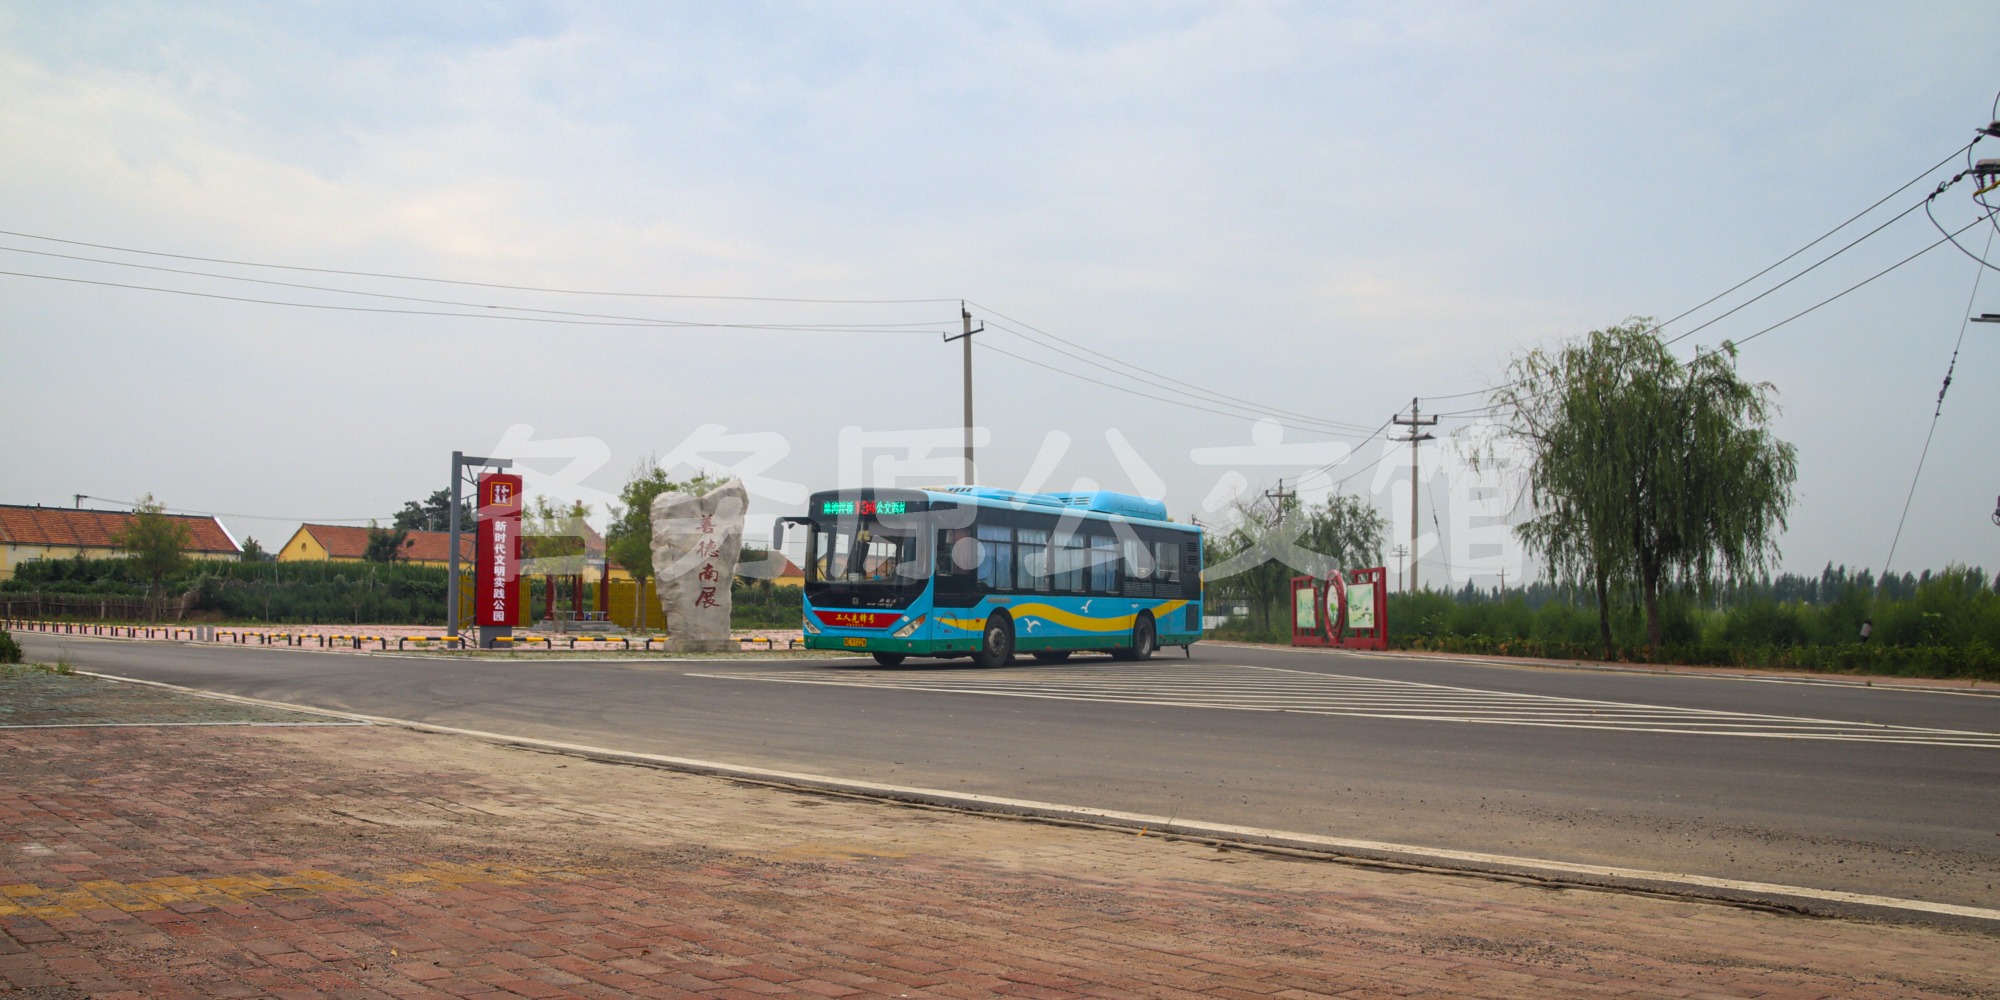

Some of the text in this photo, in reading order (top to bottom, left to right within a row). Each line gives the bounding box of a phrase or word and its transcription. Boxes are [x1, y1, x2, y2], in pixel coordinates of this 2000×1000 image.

[855, 500, 876, 515] 134
[493, 520, 507, 622] 新时代文明实践公园
[694, 514, 721, 609] 善德南展
[836, 613, 876, 624] 工人先锋号
